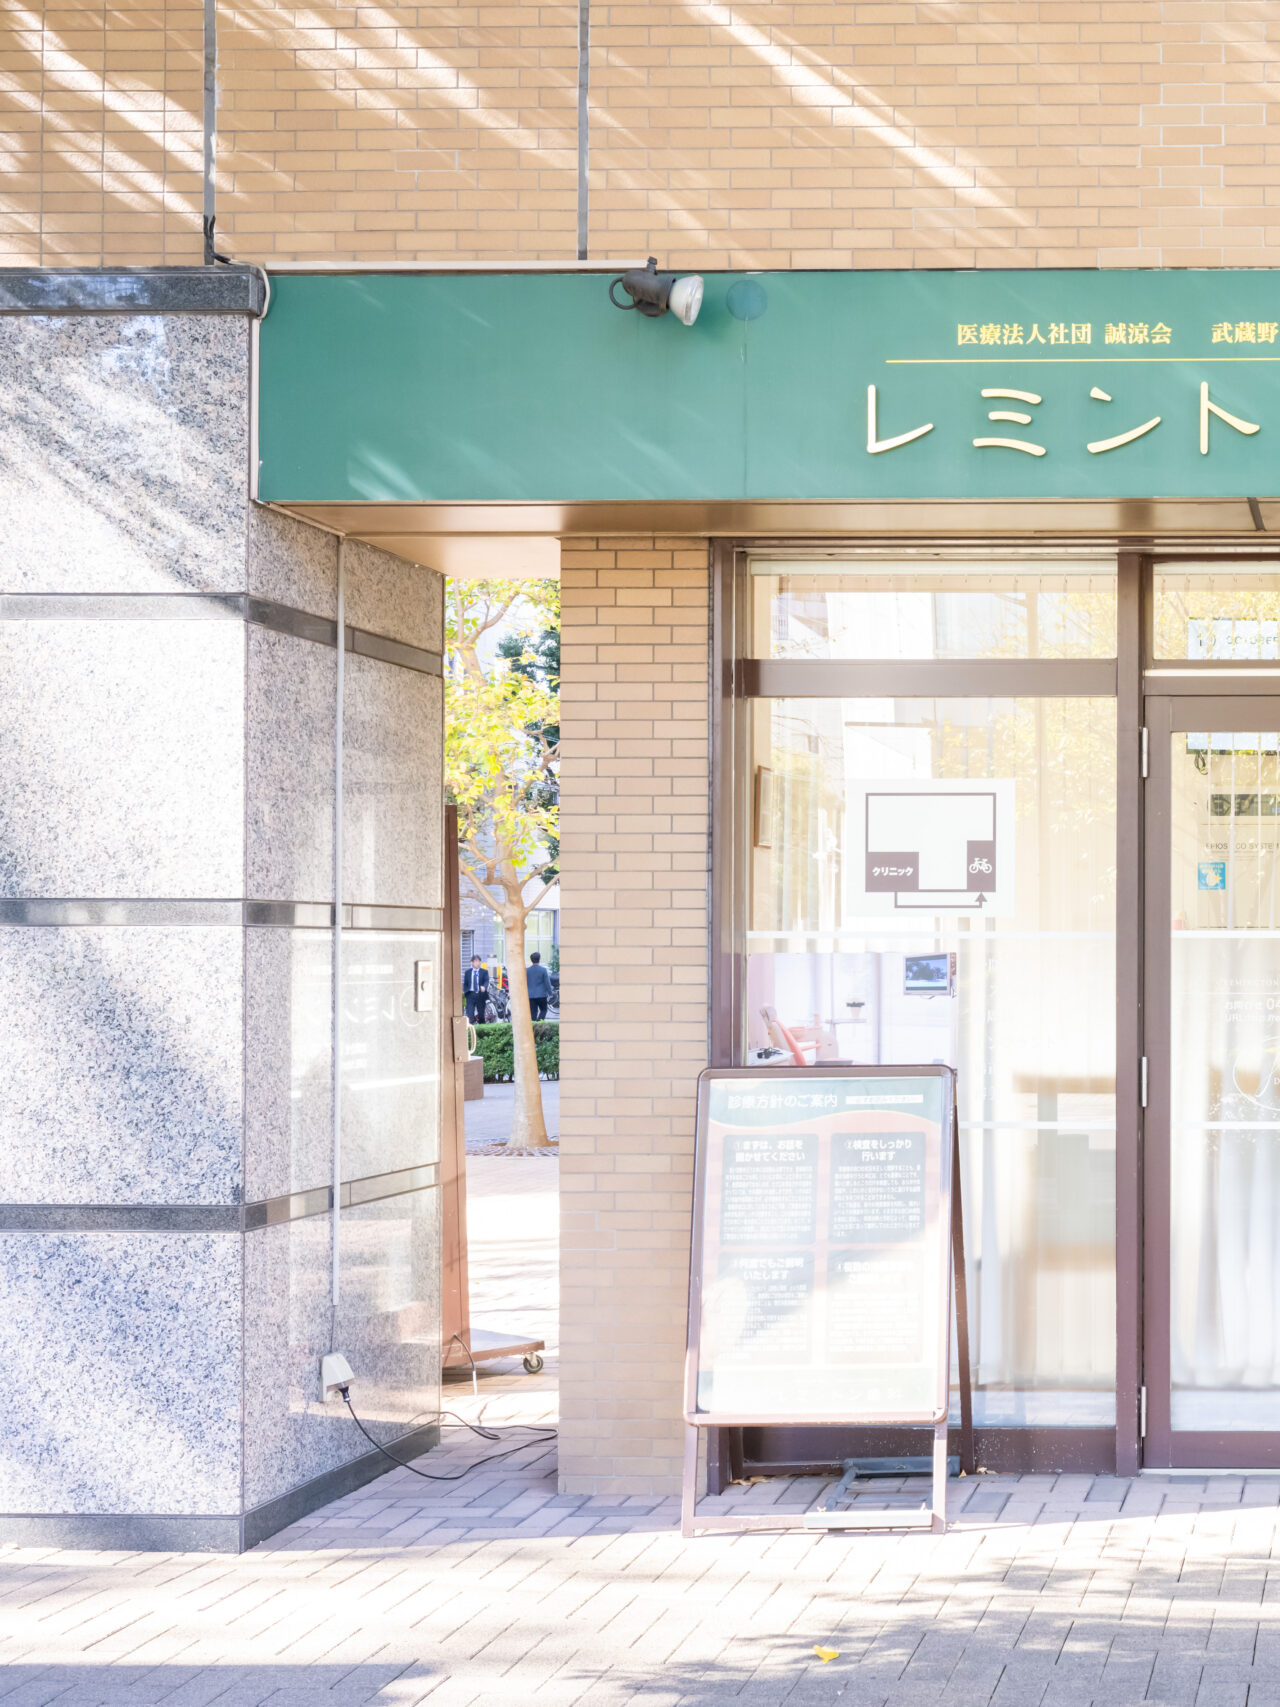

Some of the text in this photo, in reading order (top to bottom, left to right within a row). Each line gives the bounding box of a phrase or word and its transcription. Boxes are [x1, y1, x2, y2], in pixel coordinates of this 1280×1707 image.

[956, 323, 1092, 345] 医療法人社団
[1104, 323, 1173, 345] 誠涼会
[872, 866, 914, 877] クリニック
[727, 1094, 838, 1109] 診療方針のご案内
[862, 1151, 896, 1161] 行います
